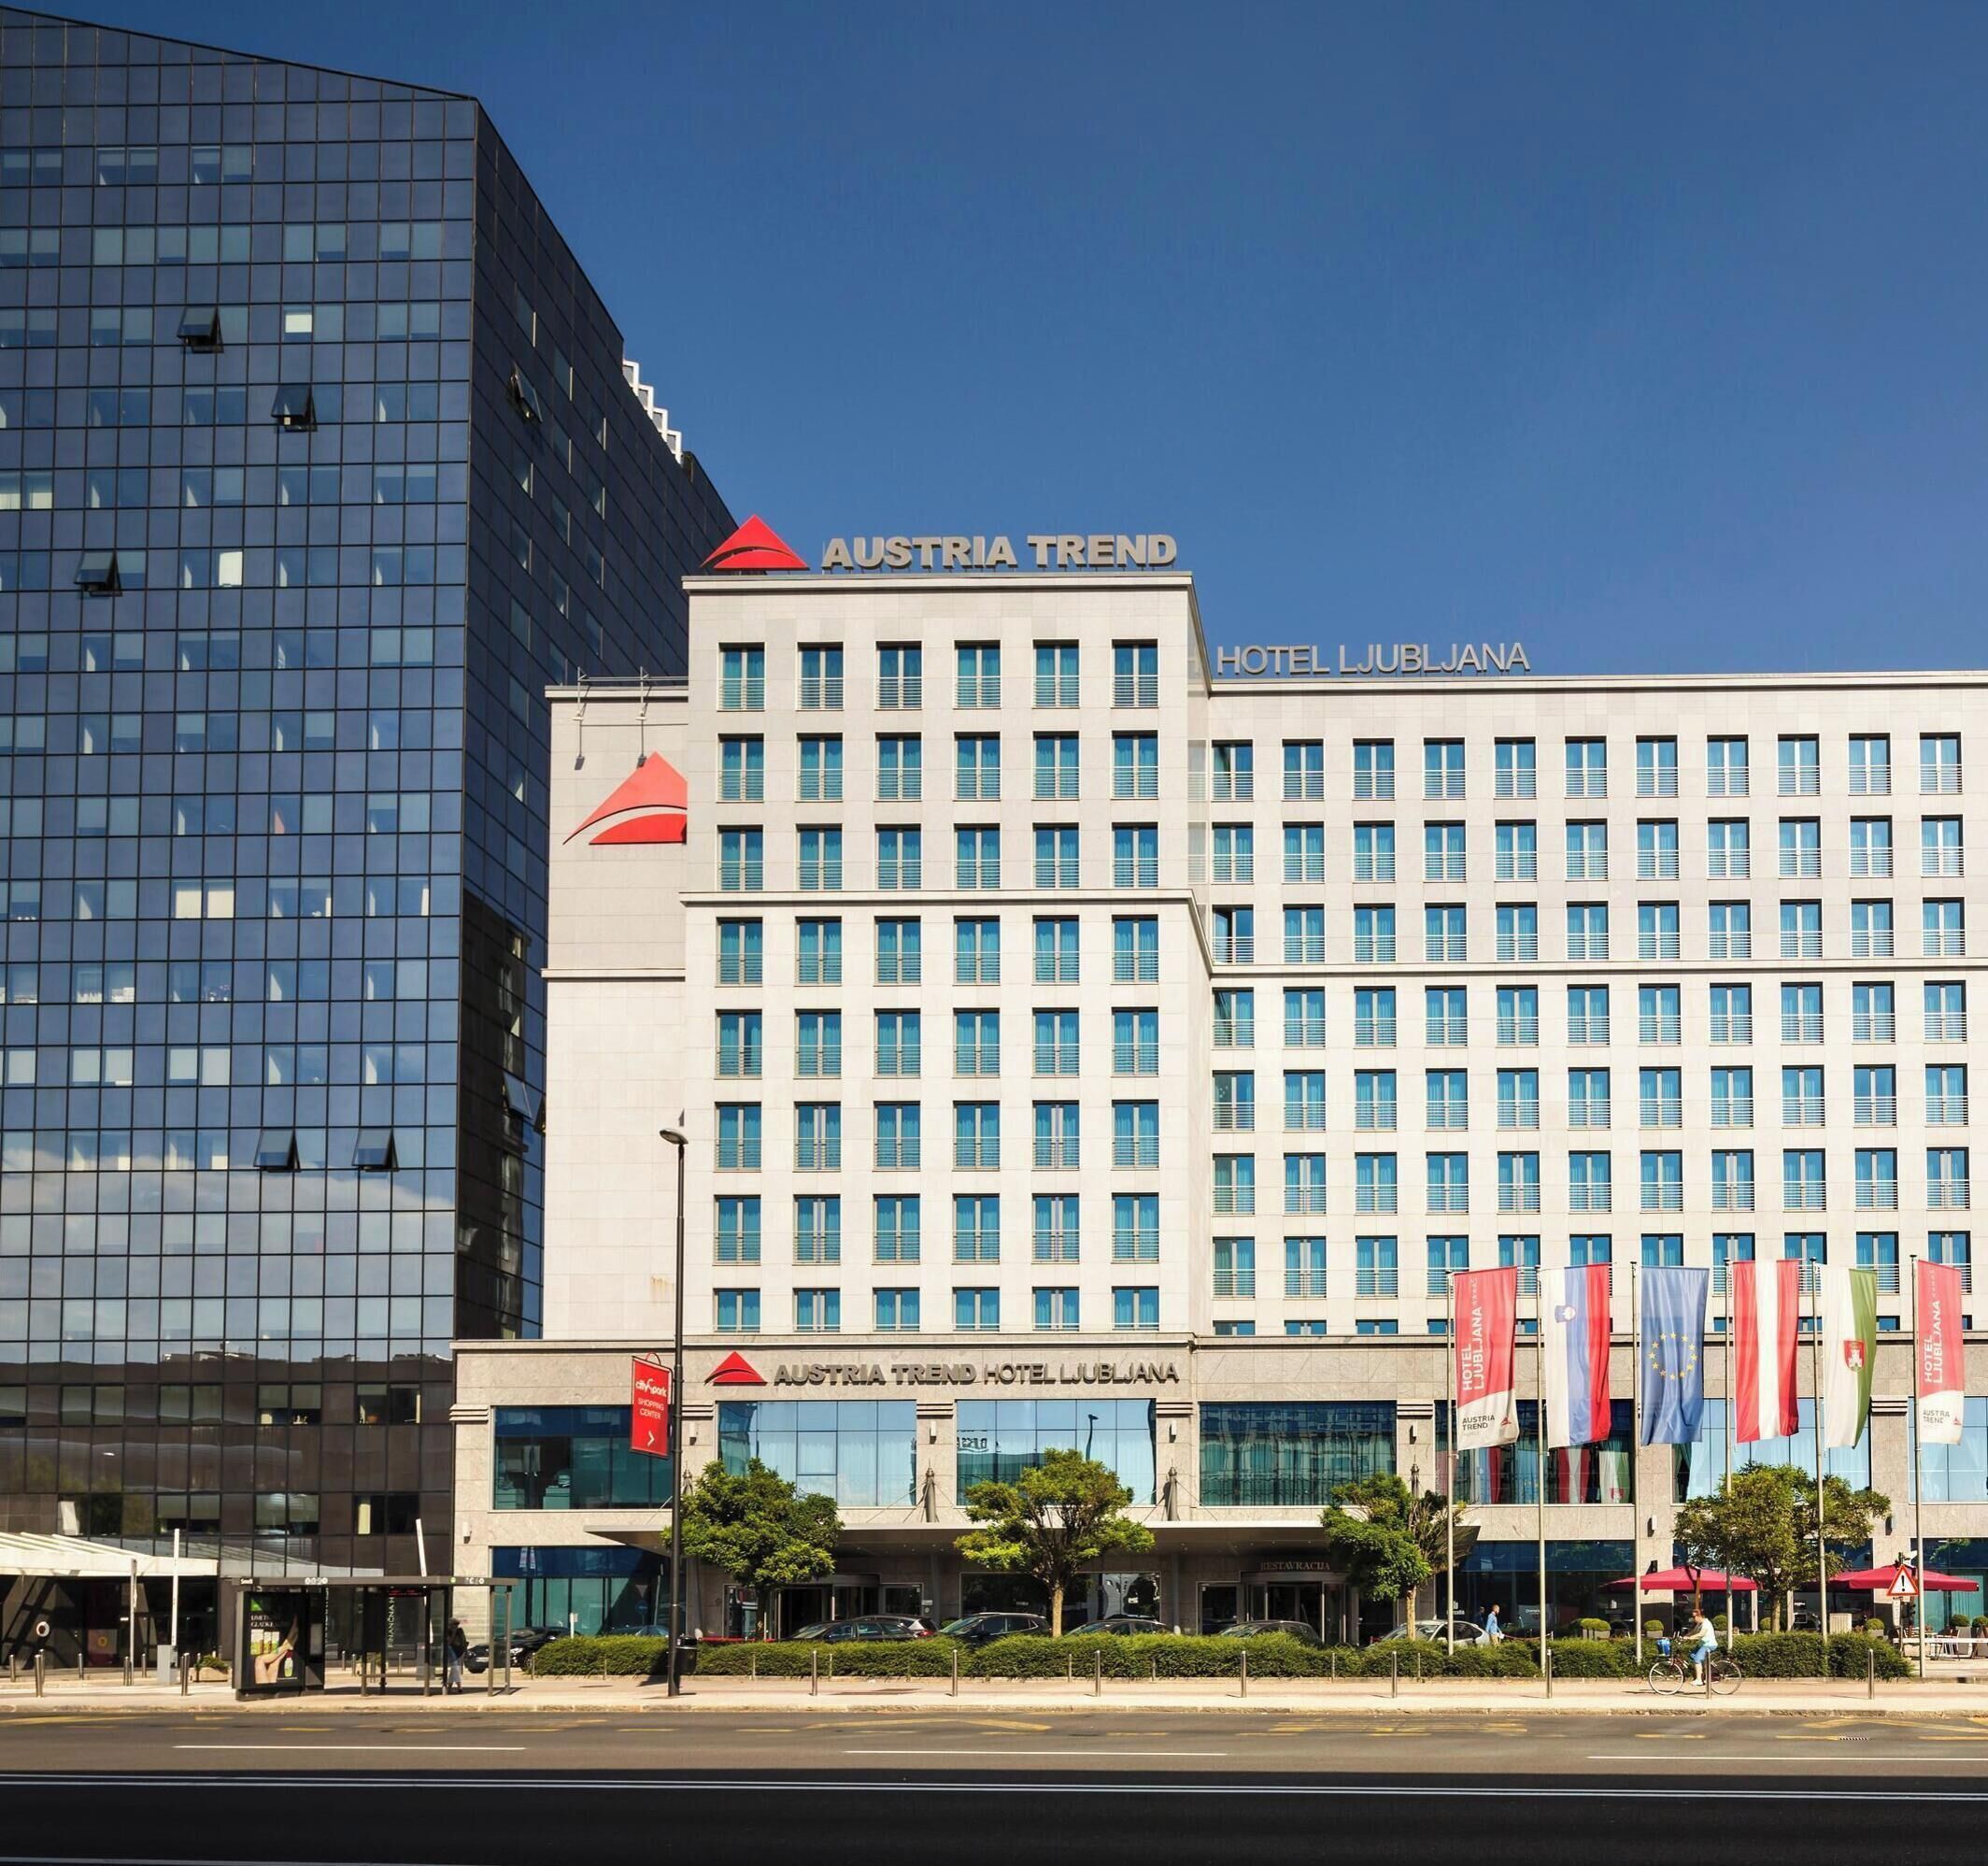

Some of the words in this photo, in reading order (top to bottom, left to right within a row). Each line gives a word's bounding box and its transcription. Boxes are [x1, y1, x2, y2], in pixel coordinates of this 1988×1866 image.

[821, 535, 1017, 568] AUSTRIA
[1028, 534, 1177, 567] TREND
[1217, 645, 1330, 675] HOTEL
[1339, 642, 1531, 674] LJUBLJANA
[1471, 1306, 1485, 1390] LJUBLJANA
[1933, 1300, 1943, 1383] LJUBLJANA
[774, 1362, 887, 1386] AUSTRIA
[891, 1363, 977, 1386] TREND
[984, 1362, 1057, 1385] HOTEL
[1059, 1361, 1180, 1385] LJUBLJANA
[1461, 1343, 1473, 1390] HOTEL
[1924, 1334, 1934, 1383] HOTEL
[637, 1397, 665, 1412] SHOPPING
[1462, 1415, 1496, 1425] AUSTRIA
[1923, 1408, 1951, 1418] AUSTRA
[1462, 1422, 1488, 1432] TREND
